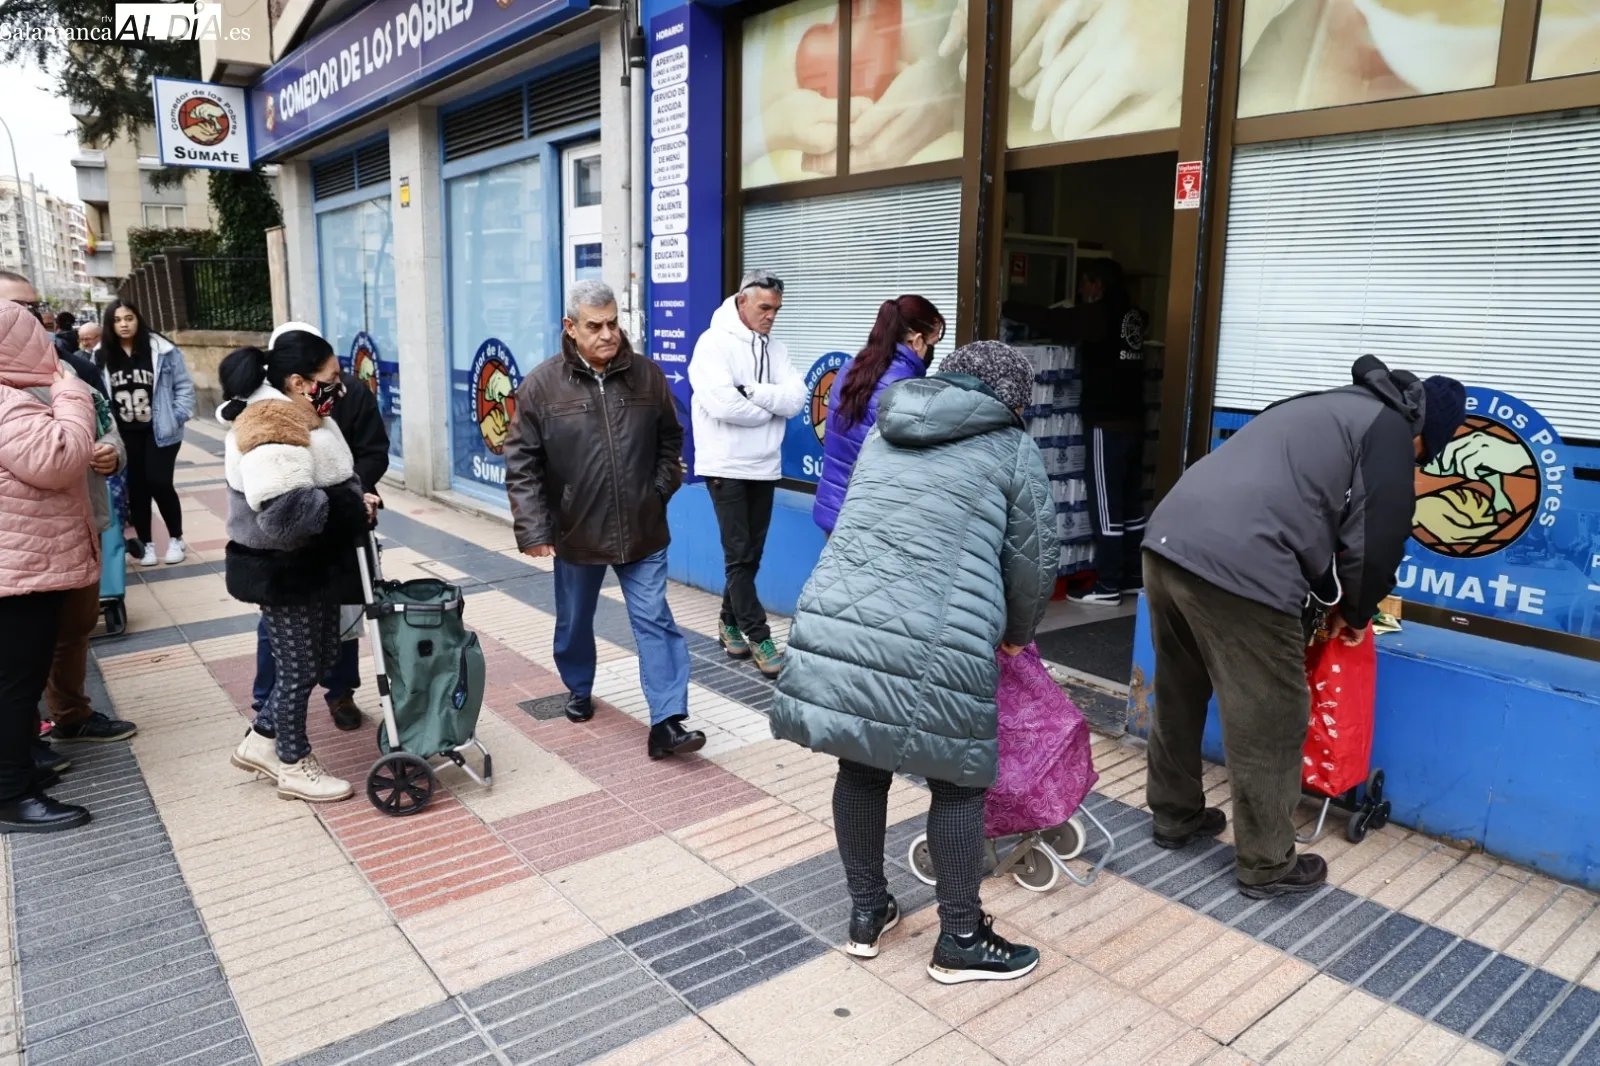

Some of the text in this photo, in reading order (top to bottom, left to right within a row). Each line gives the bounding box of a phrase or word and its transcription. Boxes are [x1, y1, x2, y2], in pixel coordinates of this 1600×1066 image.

[656, 51, 684, 67] APERTURA
[280, 57, 338, 121] COMEDOR
[340, 42, 362, 88] DE
[363, 20, 393, 75] LOS
[654, 86, 685, 103] SERVICIO DE
[171, 92, 190, 131] Comedor
[208, 91, 222, 102] los
[223, 103, 238, 135] Pobres
[657, 100, 682, 114] ACOGIDA
[653, 140, 686, 154] DISTRIBUCIÓN
[658, 155, 666, 164] DE
[658, 188, 680, 199] COMIDA
[656, 201, 682, 211] CALIENTE
[654, 250, 685, 260] EDUCATIVA
[828, 356, 841, 367] de
[471, 344, 509, 421] Comedor de los
[1465, 396, 1567, 527] e los Pobres
[1395, 555, 1547, 616] ÚMATE
